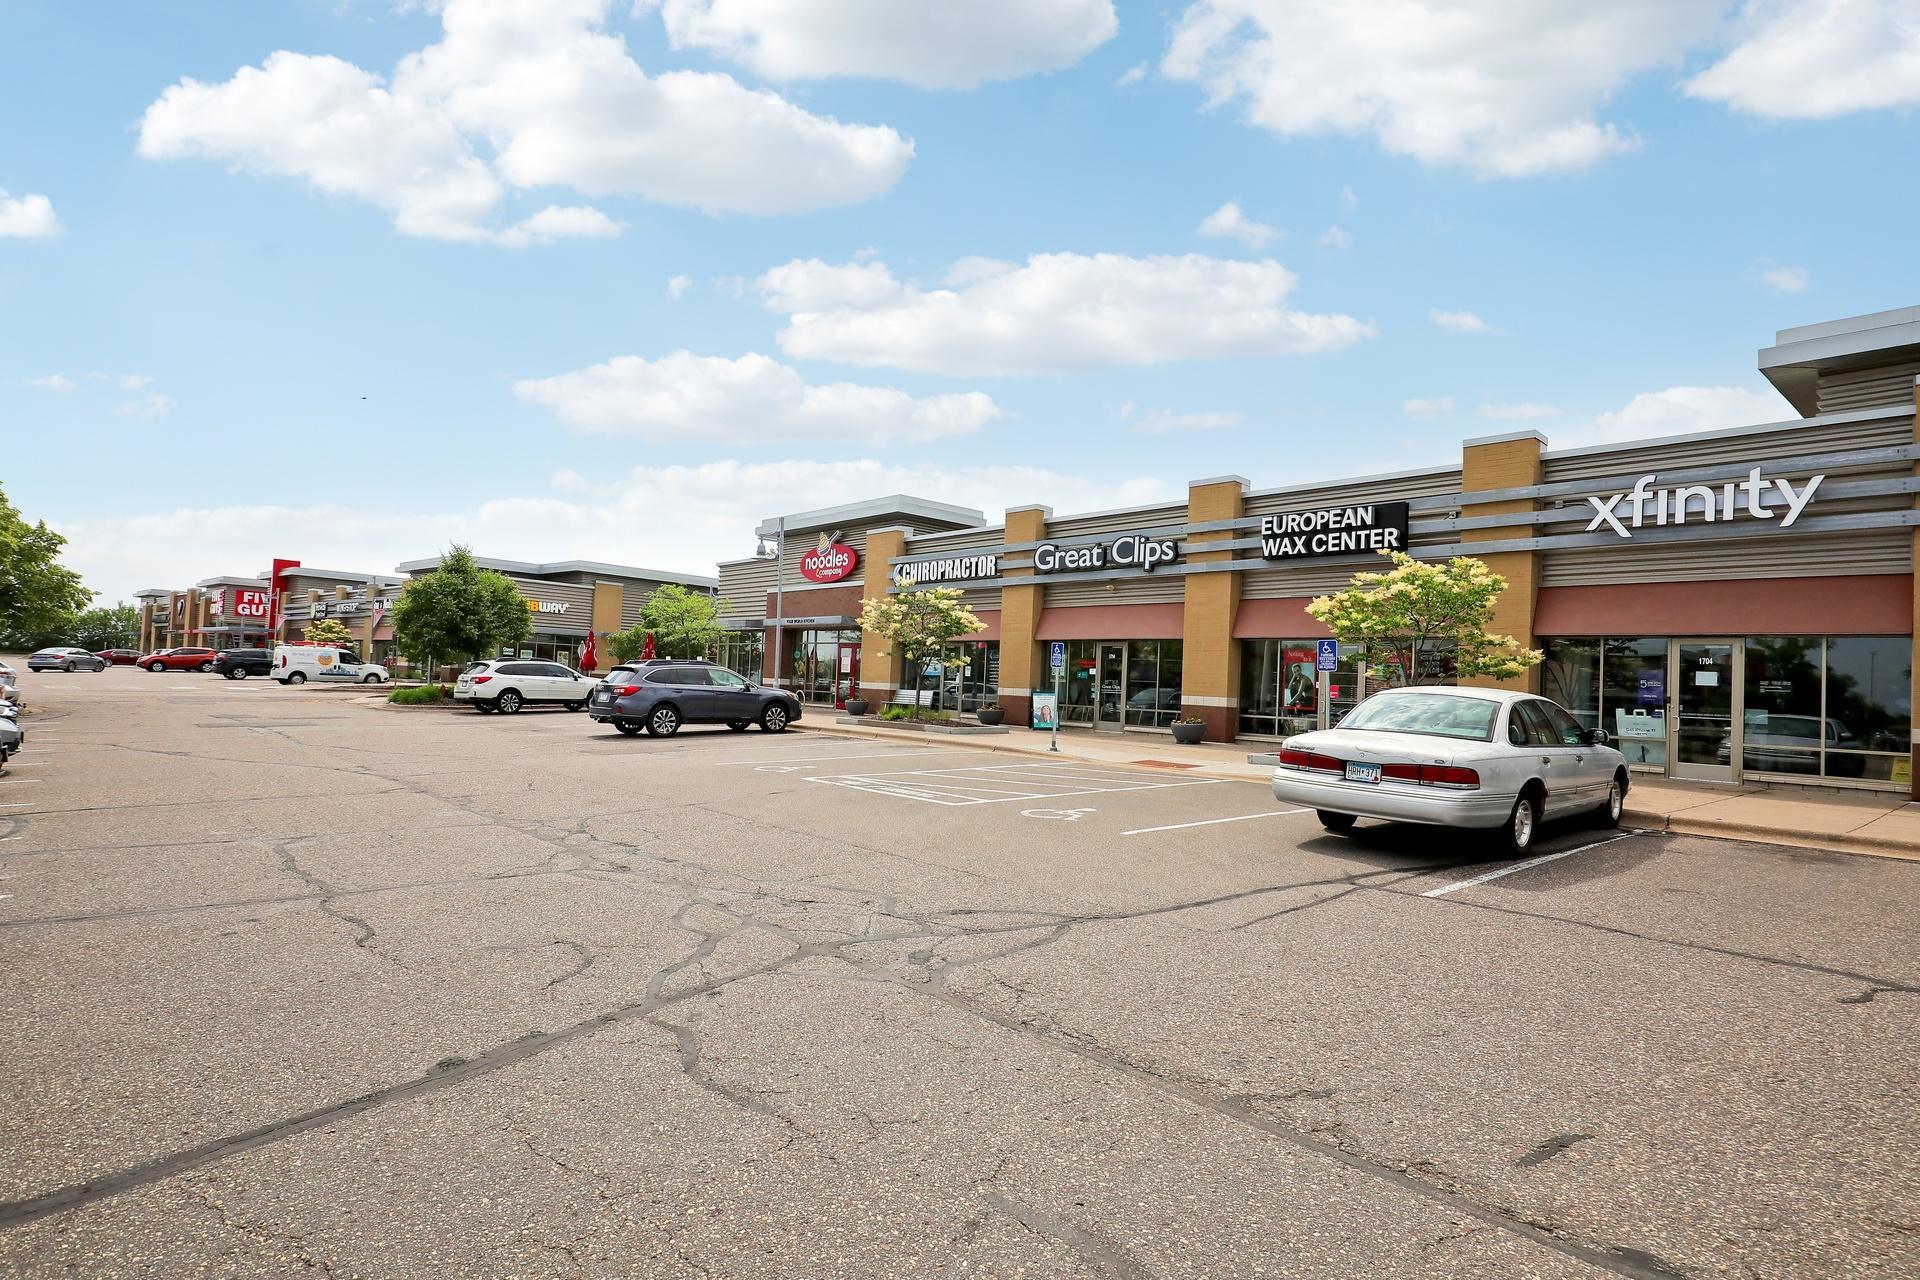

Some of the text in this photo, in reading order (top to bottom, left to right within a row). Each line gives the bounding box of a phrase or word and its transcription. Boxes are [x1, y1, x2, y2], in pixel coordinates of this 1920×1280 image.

[1585, 466, 1825, 537] xfinity
[1261, 506, 1373, 535] EUROPEAN
[1034, 536, 1174, 570] Great Clips
[1262, 528, 1399, 557] WAX CENTER
[805, 548, 849, 570] noodles
[903, 555, 996, 582] CHIROPRACTOR
[243, 591, 270, 603] FIV
[527, 600, 569, 614] BWAY
[1640, 680, 1647, 688] 5
